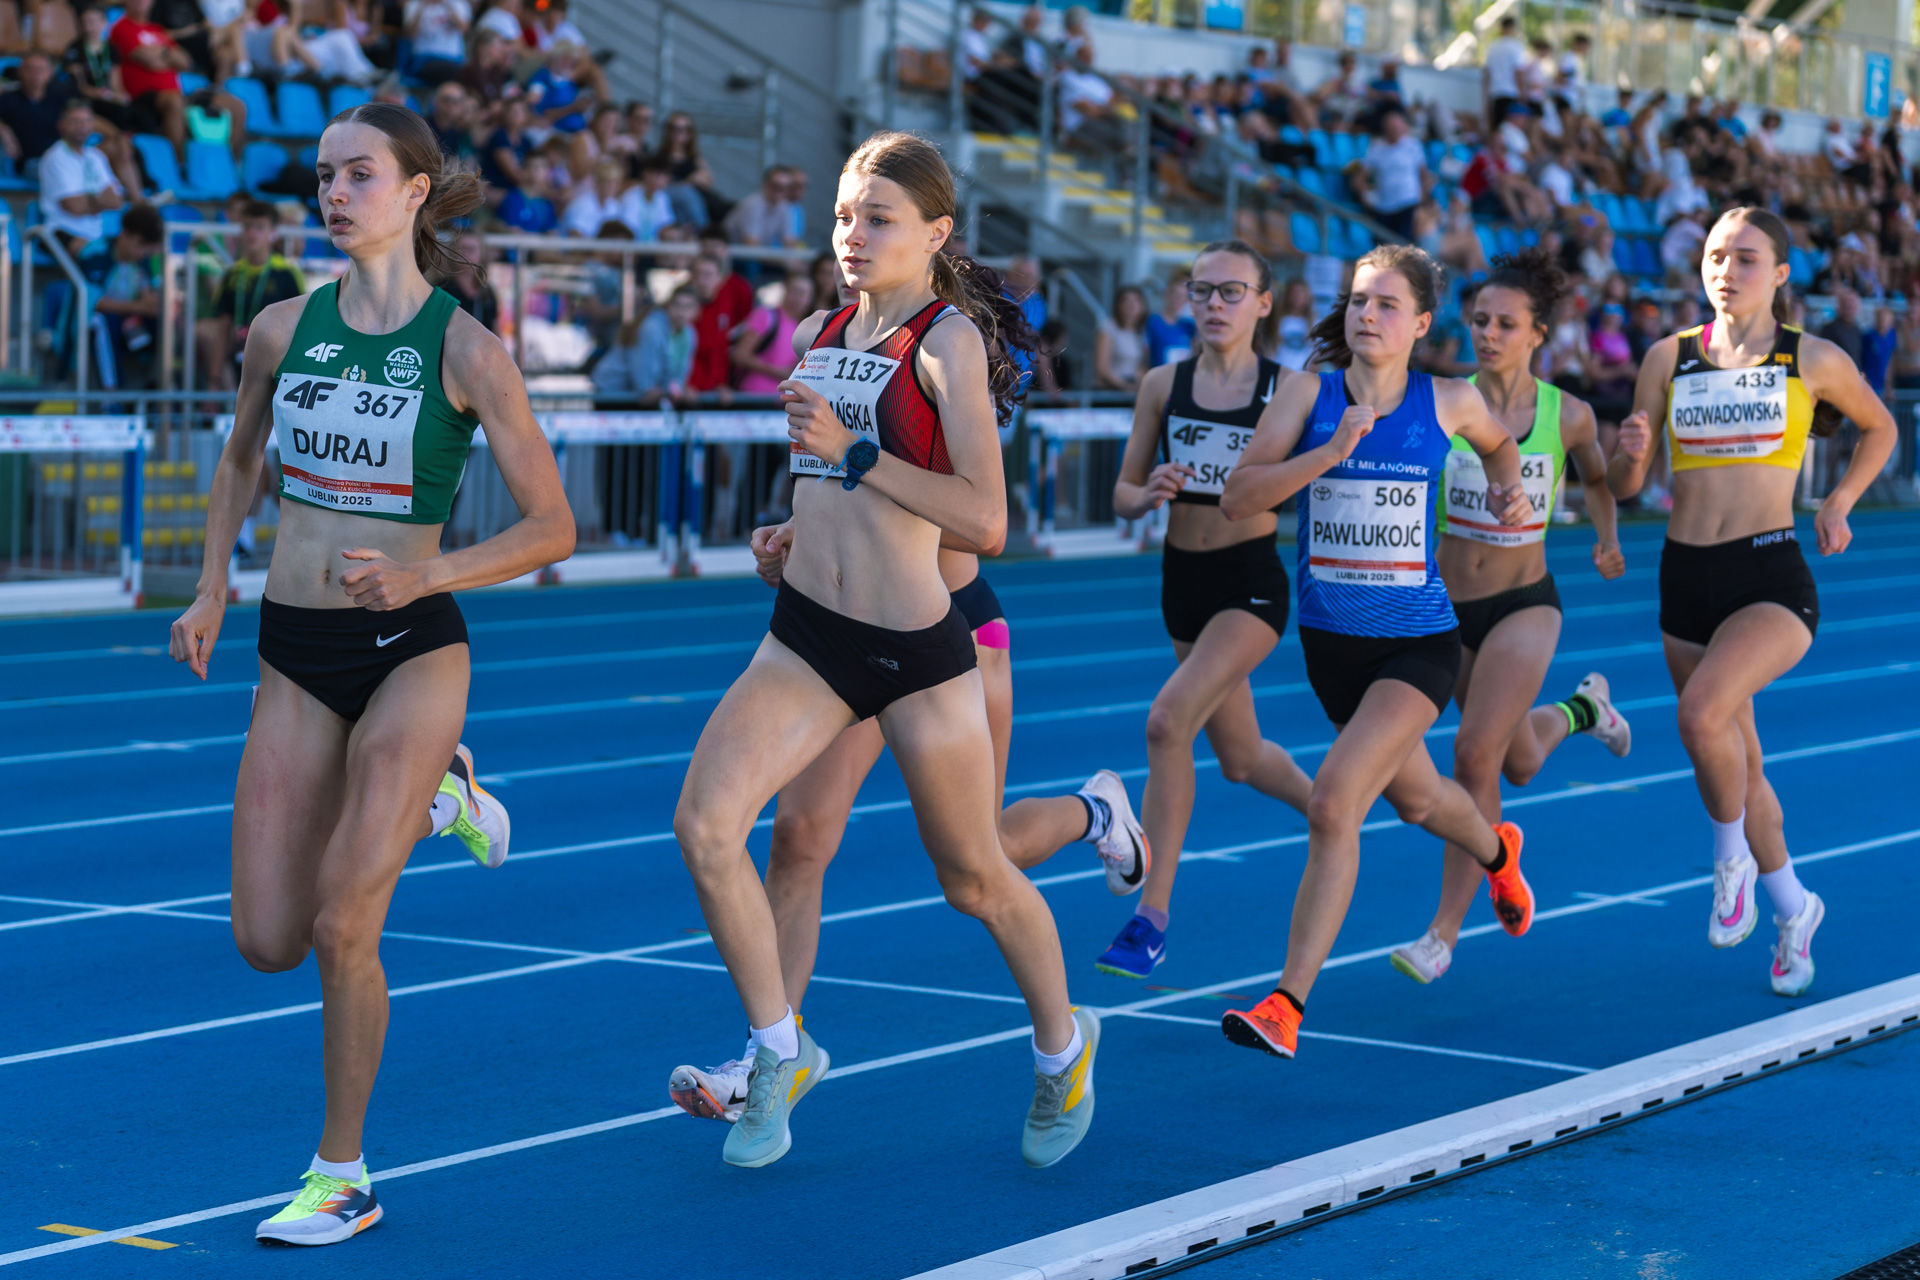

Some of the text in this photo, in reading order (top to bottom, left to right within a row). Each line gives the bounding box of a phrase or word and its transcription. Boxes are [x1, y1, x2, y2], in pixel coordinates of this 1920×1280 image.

[304, 342, 344, 363] 4F
[389, 352, 416, 365] AZS
[388, 367, 416, 380] AWF
[389, 361, 418, 371] WARSZAWA
[833, 357, 893, 384] 1137
[1735, 371, 1776, 389] 433
[283, 380, 339, 411] 4F
[353, 390, 409, 419] 367
[1675, 402, 1783, 427] ROZWADOWSKA
[1173, 423, 1214, 447] 4F
[292, 427, 388, 468] DURAJ
[799, 458, 830, 470] LUBLIN
[1175, 458, 1230, 486] ASK
[1358, 460, 1430, 477] MILANÓWEK
[307, 487, 373, 506] LUBLIN 2025
[1375, 487, 1417, 506] 506
[1449, 487, 1546, 512] GRZYKA
[1313, 520, 1422, 548] PAWLUKOJĆ
[1753, 530, 1784, 548] NIKE
[1336, 571, 1396, 581] LUBLIN 2025
